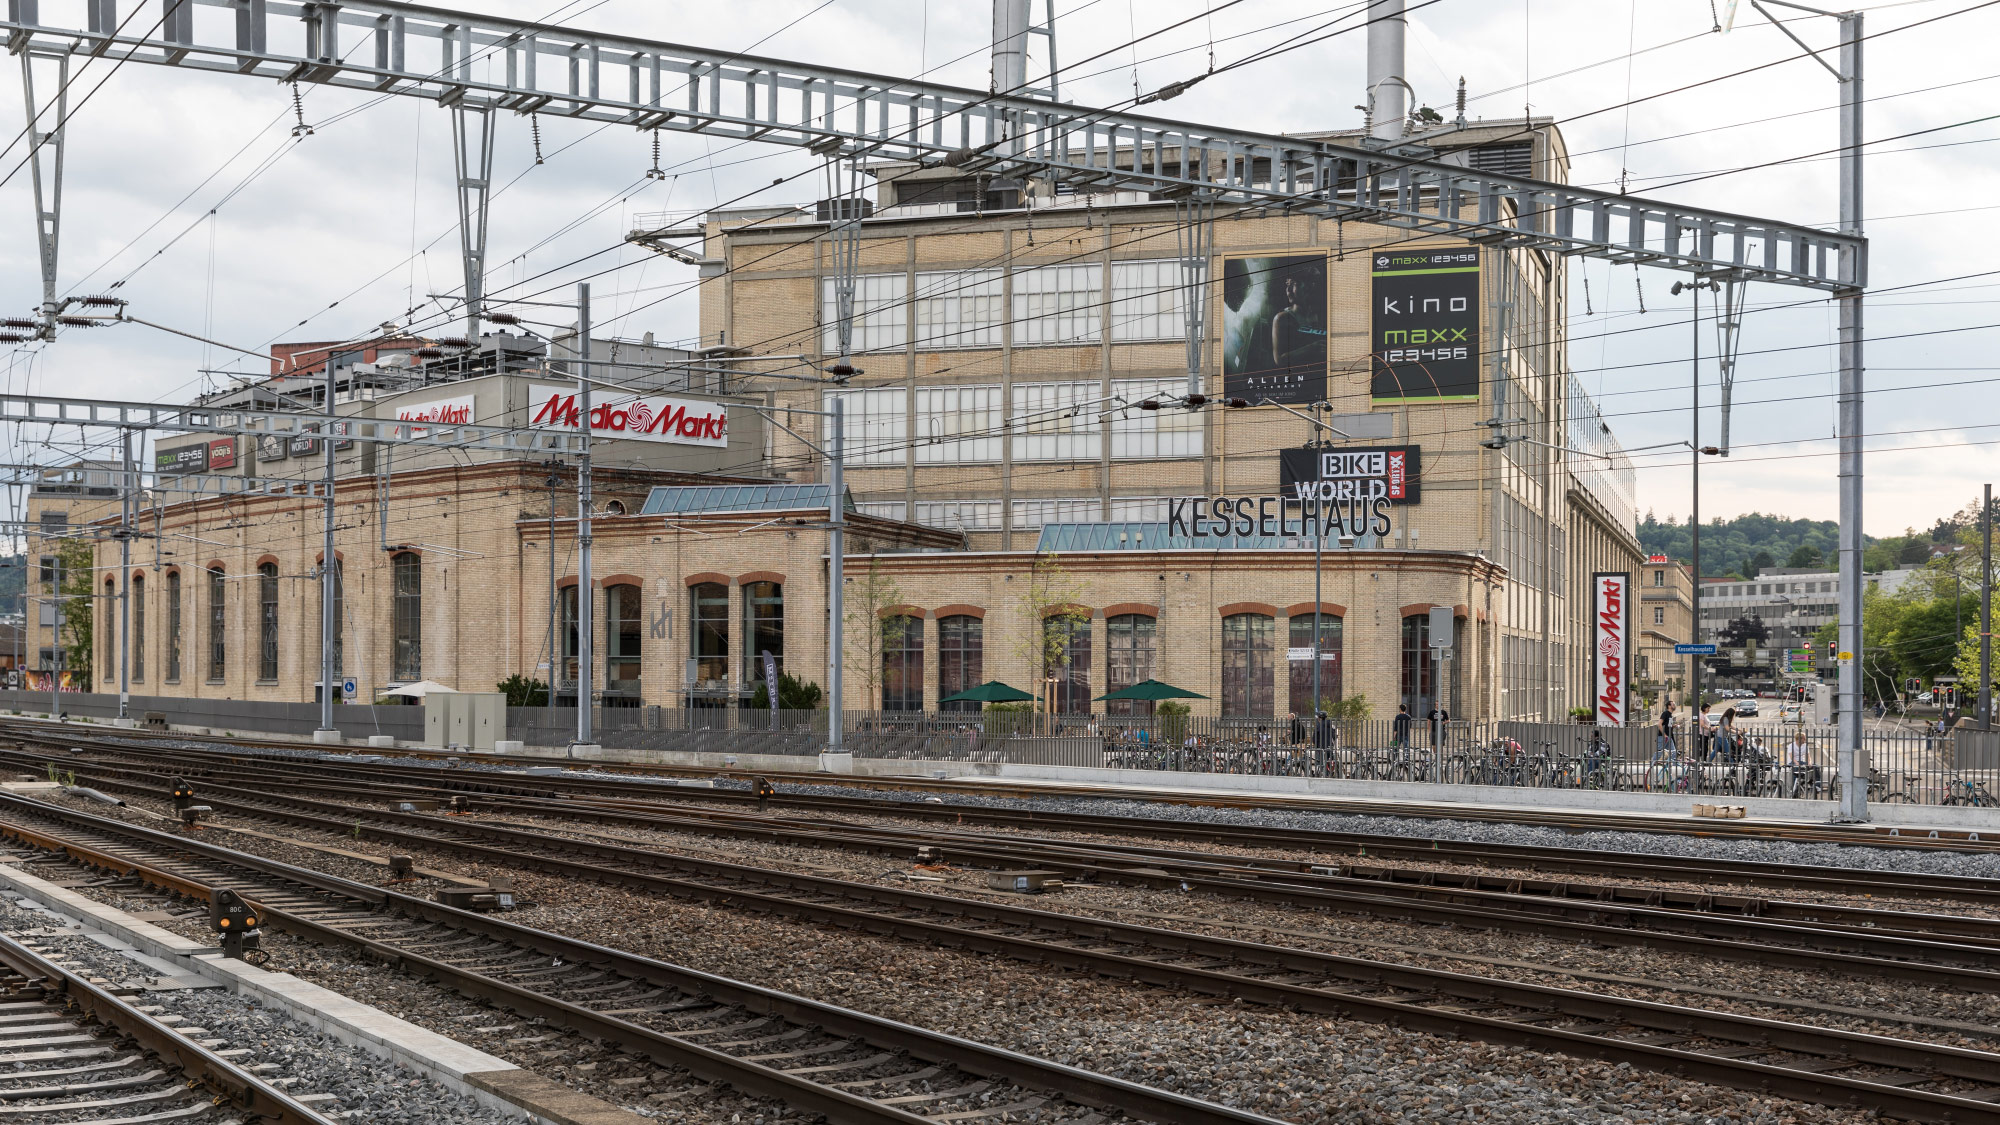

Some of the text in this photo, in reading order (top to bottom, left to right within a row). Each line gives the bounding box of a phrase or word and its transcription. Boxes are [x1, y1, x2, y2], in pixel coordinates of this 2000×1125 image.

[1392, 254, 1476, 265] maxx 123456
[1384, 295, 1467, 315] kino
[1384, 327, 1467, 345] maxx
[1384, 347, 1467, 362] 123456
[1247, 375, 1304, 384] ALIEN
[439, 404, 470, 424] Markt
[533, 394, 726, 439] Media Markt
[291, 440, 309, 452] WORLD
[157, 454, 177, 465] maxx
[177, 449, 203, 462] 123456
[1326, 454, 1382, 475] BIKE
[1294, 479, 1387, 501] WORLD
[1167, 496, 1392, 538] KESSELHAUS
[1599, 578, 1621, 726] Media Markt
